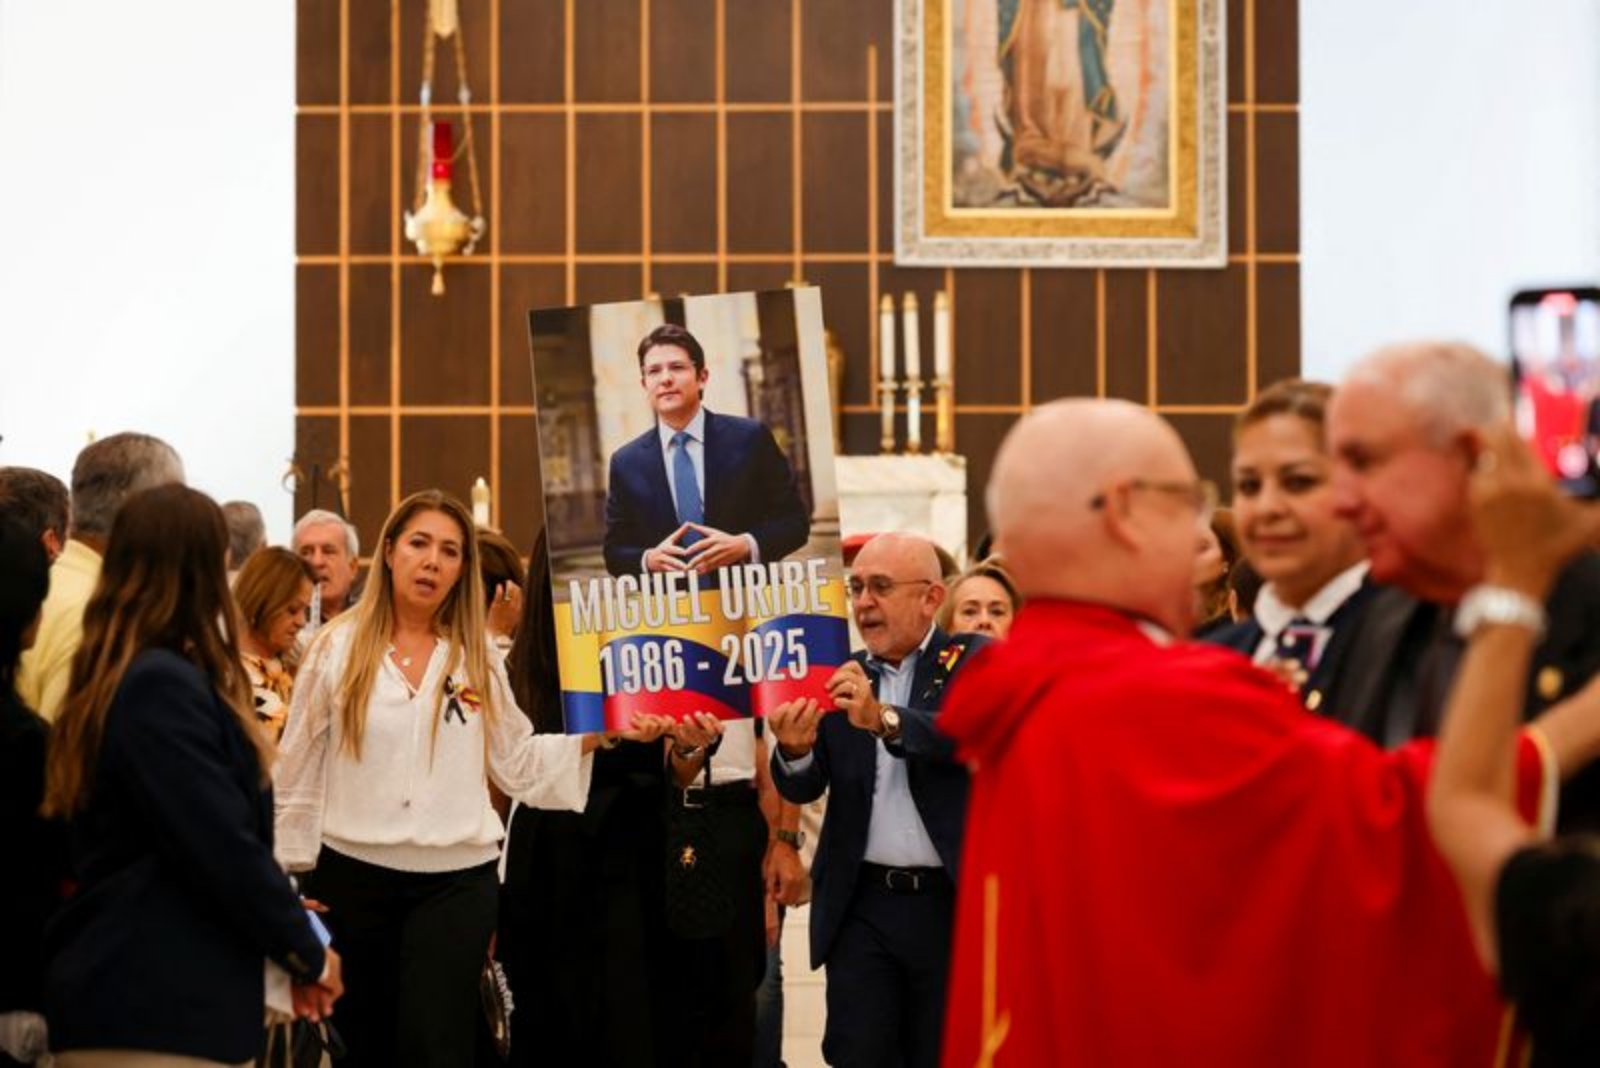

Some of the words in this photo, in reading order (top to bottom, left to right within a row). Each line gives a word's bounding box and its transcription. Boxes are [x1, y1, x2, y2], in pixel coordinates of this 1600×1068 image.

[570, 571, 710, 634] MIGUEL
[719, 559, 830, 620] URIBE
[601, 640, 684, 695] 1986
[697, 661, 709, 670] -
[722, 629, 807, 685] 2025
